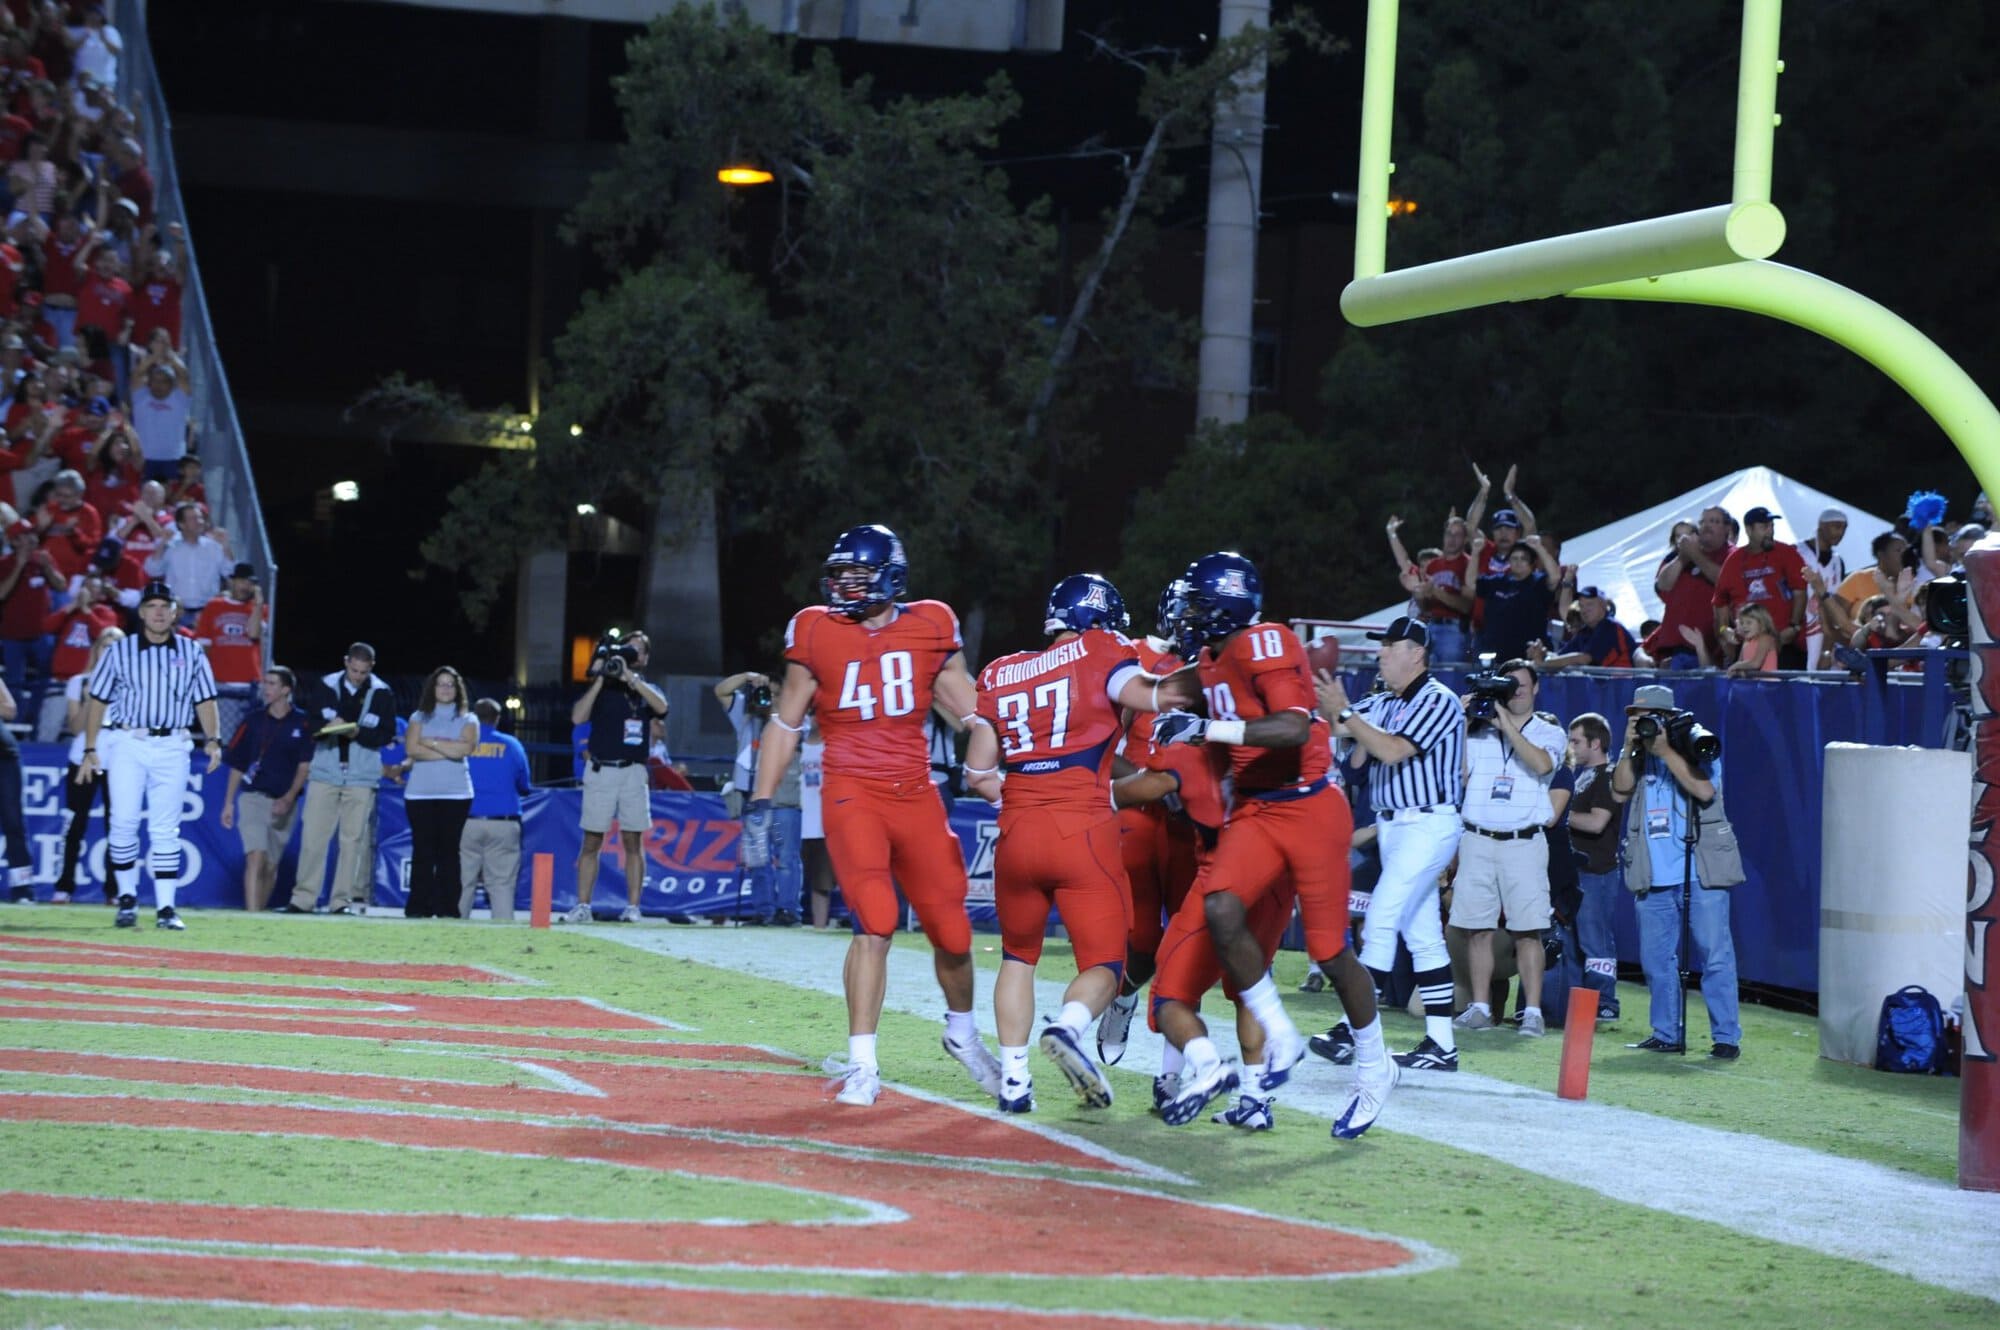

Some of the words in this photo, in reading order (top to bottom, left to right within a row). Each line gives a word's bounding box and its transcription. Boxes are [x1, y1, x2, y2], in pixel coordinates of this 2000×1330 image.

[1073, 582, 1109, 612] A
[996, 638, 1088, 687] GRONKOWSKI
[1248, 629, 1284, 661] 18
[838, 651, 915, 720] 48
[997, 677, 1070, 757] 37
[1022, 760, 1060, 772] ARIZONA
[599, 819, 748, 873] ARIZ
